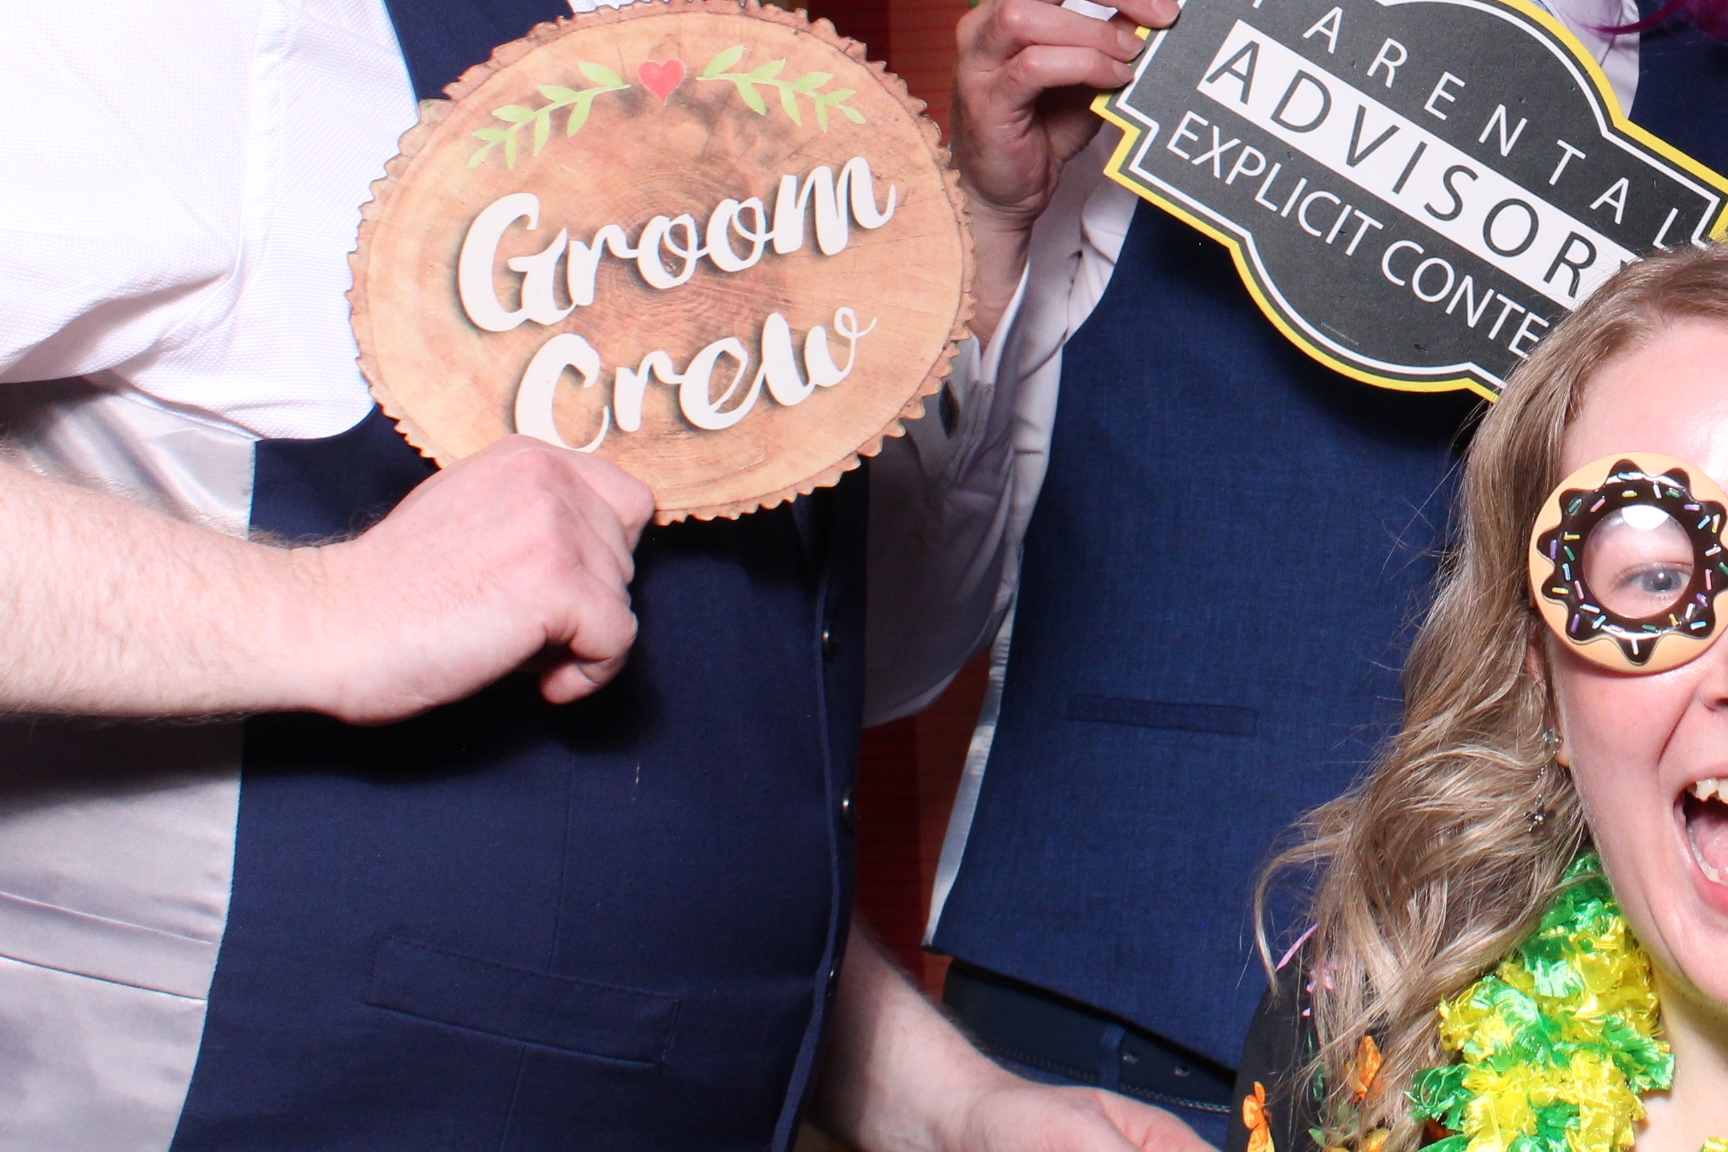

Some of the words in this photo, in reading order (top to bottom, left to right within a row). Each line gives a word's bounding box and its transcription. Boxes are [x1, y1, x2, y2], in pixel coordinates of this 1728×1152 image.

[458, 155, 896, 332] Groom
[1167, 110, 1383, 256] EXPLICIT
[1382, 240, 1549, 361] CONTE
[1204, 39, 1638, 299] ADVISOR
[515, 306, 878, 454] Crew
